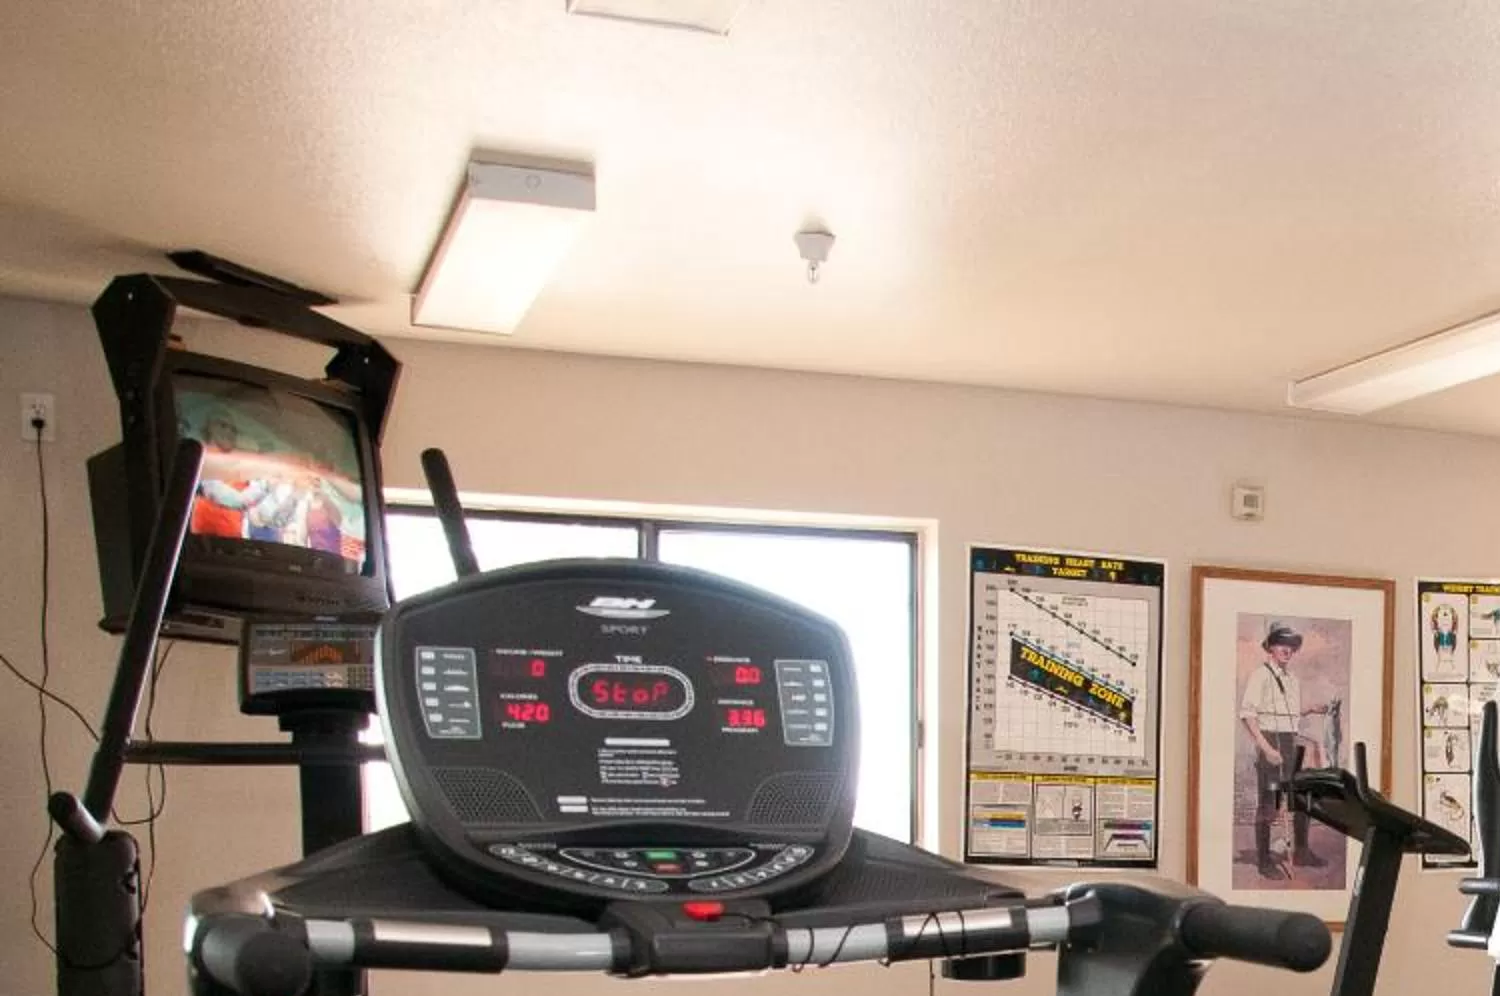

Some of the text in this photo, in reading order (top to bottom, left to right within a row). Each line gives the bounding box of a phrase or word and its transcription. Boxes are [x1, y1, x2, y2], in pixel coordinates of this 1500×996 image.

[615, 655, 643, 664] TIME
[1020, 646, 1125, 709] TRAINING ZONE
[507, 702, 550, 722] 420
